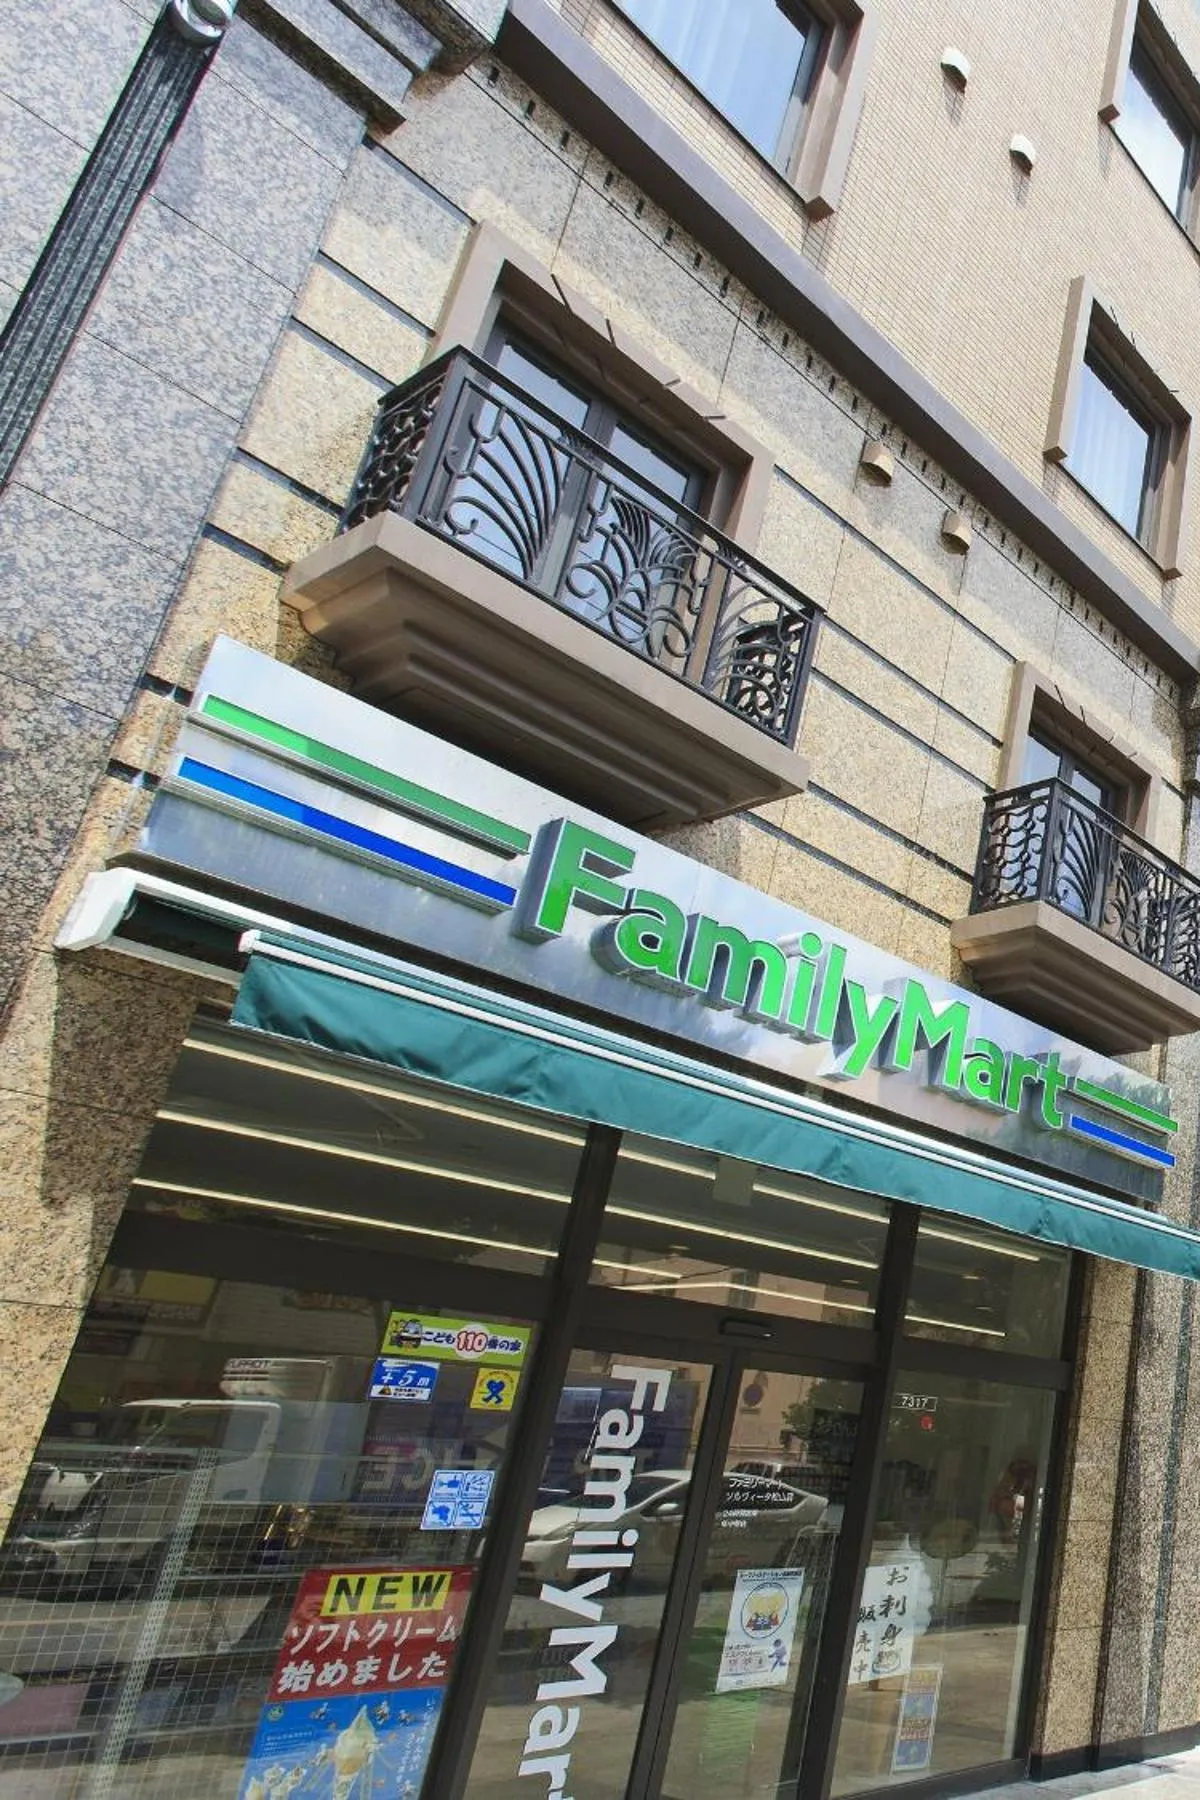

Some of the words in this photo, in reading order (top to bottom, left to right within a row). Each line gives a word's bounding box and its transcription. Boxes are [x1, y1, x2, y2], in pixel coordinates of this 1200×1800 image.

[532, 816, 1068, 1129] FamilyMart
[329, 1574, 448, 1614] NEW
[518, 1364, 673, 1800] FamilyMar
[289, 1614, 457, 1655] ソフトクリーム
[277, 1650, 447, 1694] 始めました
